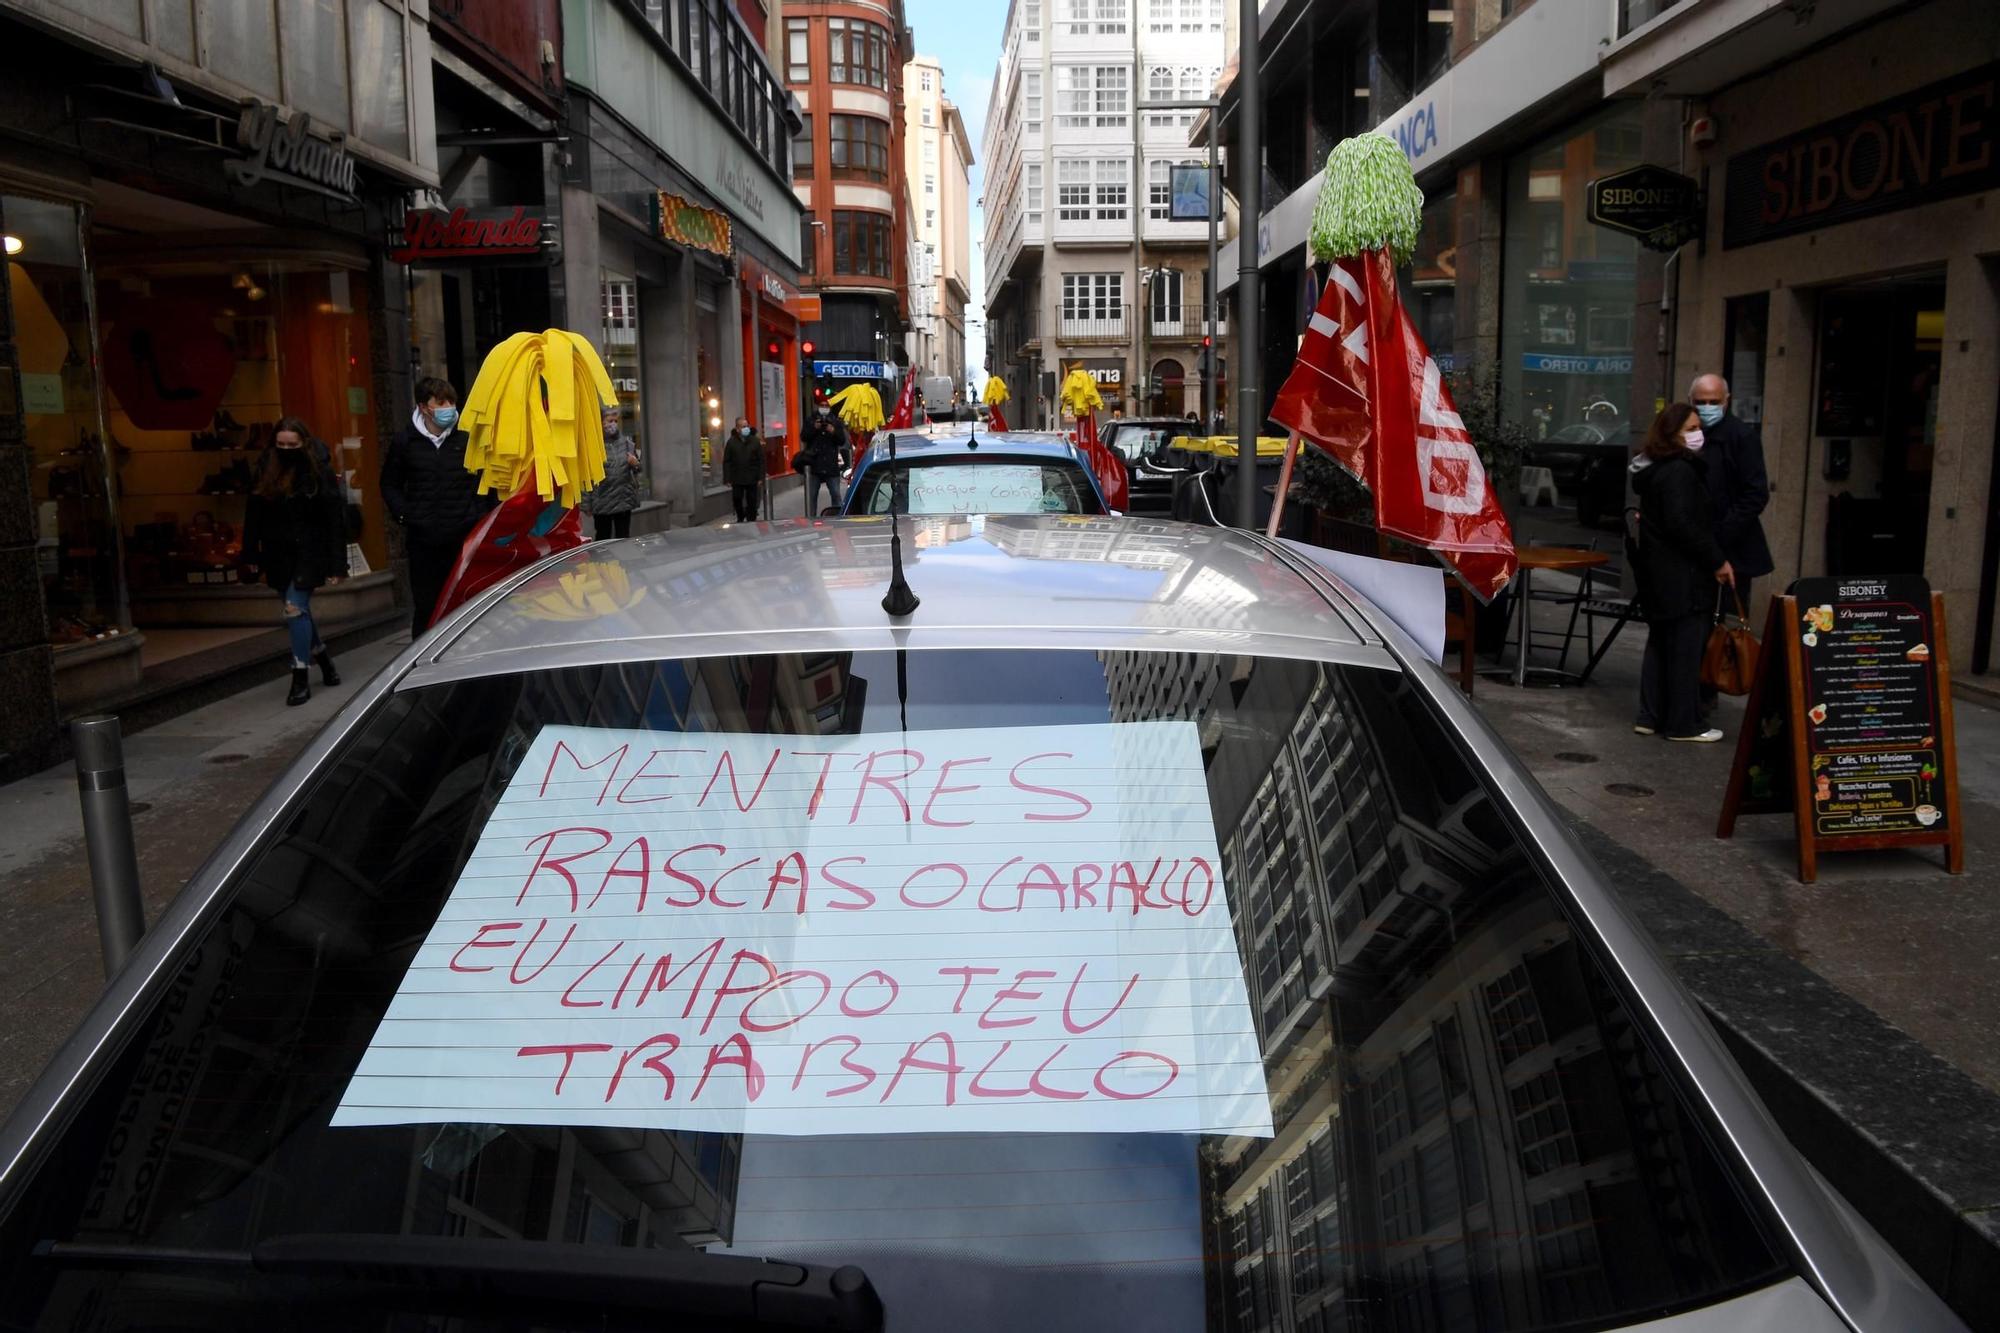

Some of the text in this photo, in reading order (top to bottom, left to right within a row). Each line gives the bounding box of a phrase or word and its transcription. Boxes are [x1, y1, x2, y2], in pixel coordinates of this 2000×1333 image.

[229, 97, 357, 203] Yolanda
[1391, 101, 1437, 162] NCA
[1600, 187, 1687, 205] SIBONEY
[390, 205, 542, 264] Yolanda
[1838, 585, 1887, 596] SIBONEY
[539, 740, 1093, 827] MENTRES
[515, 826, 1214, 917] RASCAS O CARALLO
[449, 918, 1140, 1036] EU LIMPO O TEU
[516, 1031, 1180, 1107] TRABALLO
